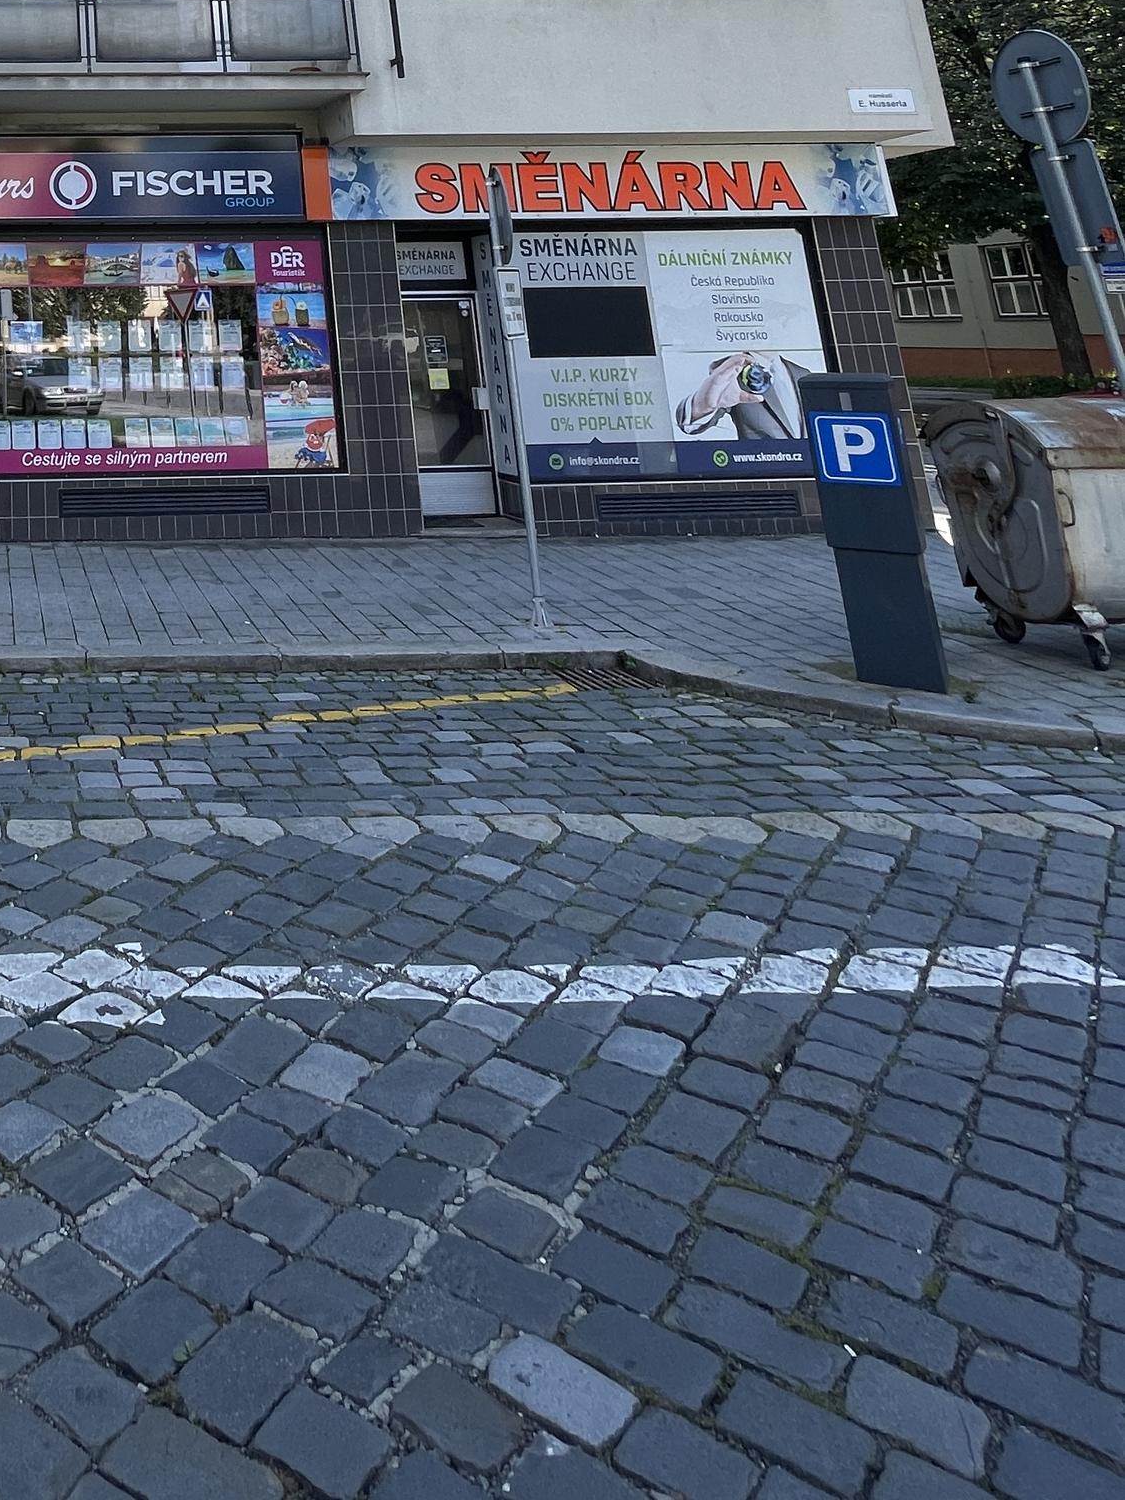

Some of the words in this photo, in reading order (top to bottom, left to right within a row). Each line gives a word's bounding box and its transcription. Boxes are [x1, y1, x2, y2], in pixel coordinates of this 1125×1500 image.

[858, 100, 867, 108] E.
[869, 100, 908, 108] Husserla
[111, 169, 275, 197] FISCHER
[414, 150, 808, 214] SMĚNÁRNA
[225, 197, 275, 208] GROUP
[396, 247, 456, 260] SMĚNÁRNA
[520, 233, 638, 257] SMĚNÁRNA
[270, 246, 305, 268] DER
[658, 249, 726, 266] DÁLNIČNÍ
[730, 249, 792, 265] ZNÁMKY
[272, 269, 305, 277] Touristik
[399, 264, 455, 276] EXCHANGE
[527, 261, 637, 282] EXCHANGE
[690, 274, 721, 287] Česká
[724, 275, 775, 290] Republika
[711, 293, 760, 305] Slovinsko
[714, 311, 763, 323] Rakousko
[551, 368, 586, 383] V.I.P.
[590, 367, 638, 382] KURZY
[543, 389, 619, 407] DISKRÉTNÍ
[624, 391, 654, 406] BOX
[550, 417, 573, 432] 0%
[578, 415, 653, 431] POPLATEK
[831, 424, 875, 472] P
[22, 452, 81, 469] Cestujte
[84, 454, 102, 465] se
[105, 451, 151, 469] silným
[154, 451, 228, 467] partnerem
